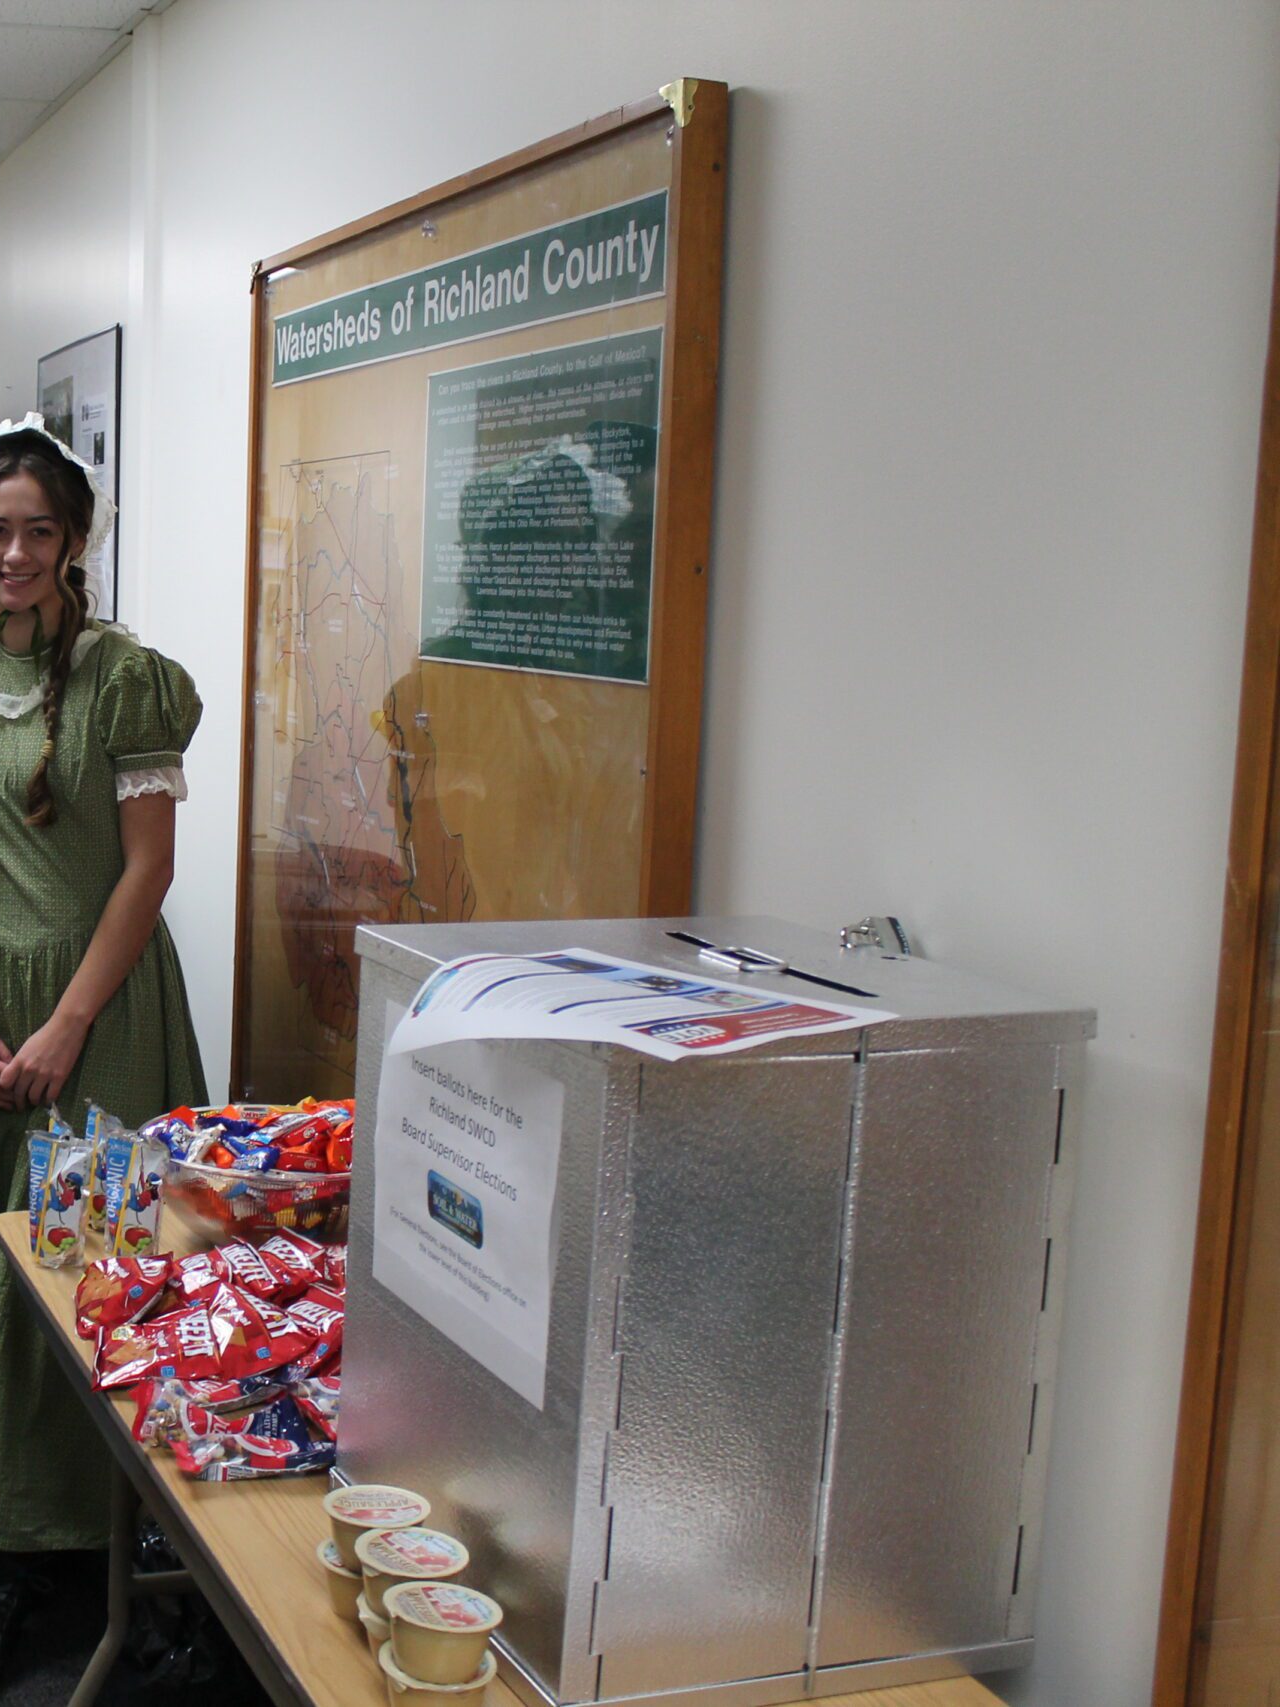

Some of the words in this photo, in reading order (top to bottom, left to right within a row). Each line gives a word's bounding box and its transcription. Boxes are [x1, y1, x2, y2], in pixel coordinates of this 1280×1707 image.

[276, 300, 382, 365] Watersheds
[391, 286, 414, 335] of
[424, 250, 530, 327] Richland
[543, 220, 660, 295] County
[511, 366, 538, 382] Richland
[539, 361, 563, 378] County,
[575, 356, 586, 370] the
[588, 353, 602, 368] Gulf
[614, 344, 647, 363] Mexico?
[660, 1026, 714, 1043] VOTE
[411, 1055, 436, 1082] Insert
[436, 1067, 465, 1098] ballots
[467, 1083, 488, 1110] here
[489, 1096, 504, 1118] for
[506, 1106, 524, 1130] the
[429, 1096, 466, 1130] Richland
[467, 1118, 496, 1148] SWCD
[29, 1158, 48, 1220] ORGANIC
[106, 1158, 126, 1219] ORGANIC
[402, 1116, 426, 1145] Board
[428, 1132, 473, 1174] Supervisor
[475, 1162, 518, 1202] Elections
